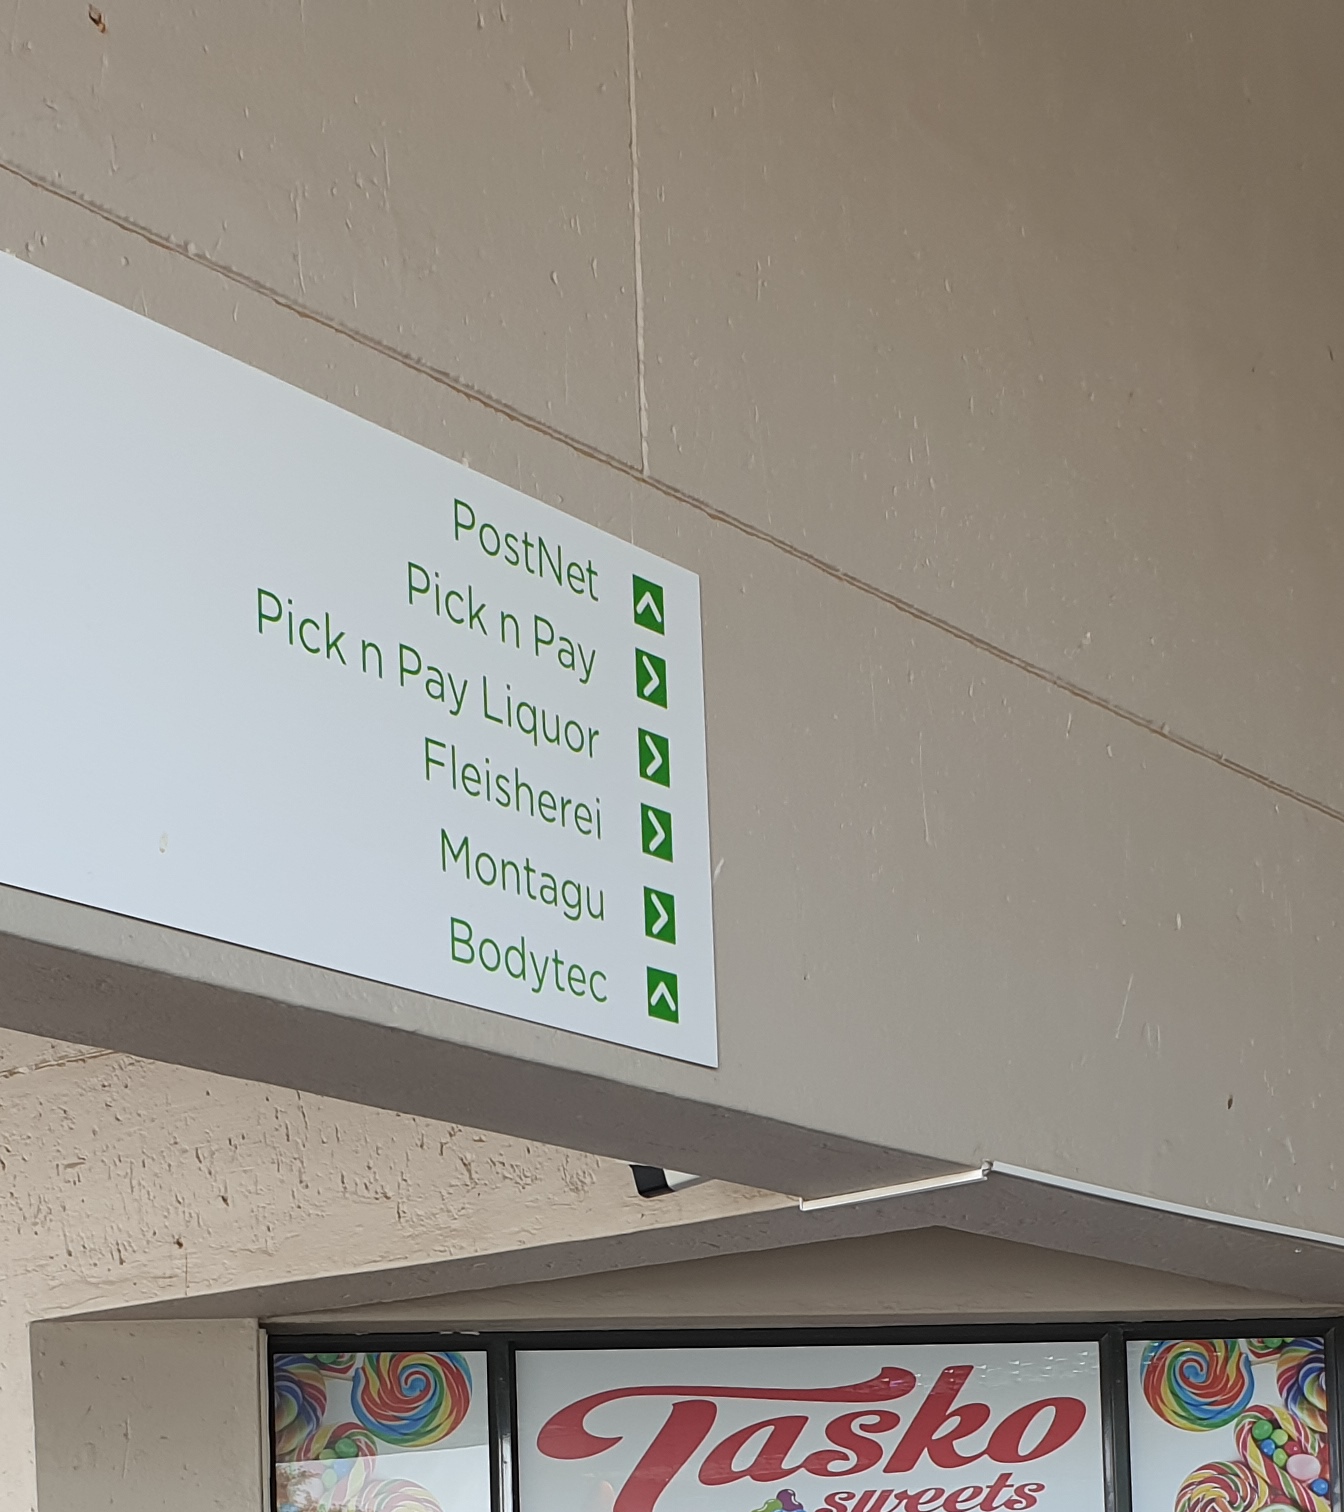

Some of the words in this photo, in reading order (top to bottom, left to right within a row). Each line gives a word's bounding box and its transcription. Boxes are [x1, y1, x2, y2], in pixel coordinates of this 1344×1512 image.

[453, 498, 599, 603] PostNet
[256, 588, 346, 667] Pick
[361, 639, 383, 680] n
[398, 643, 468, 717] Pay
[482, 674, 600, 759] Liquor
[407, 562, 488, 636] Pick
[500, 610, 520, 649] n
[534, 615, 597, 685] Pay
[423, 737, 602, 840] Fleisherei
[440, 828, 605, 922] Montagu
[450, 916, 608, 1003] Bodytec
